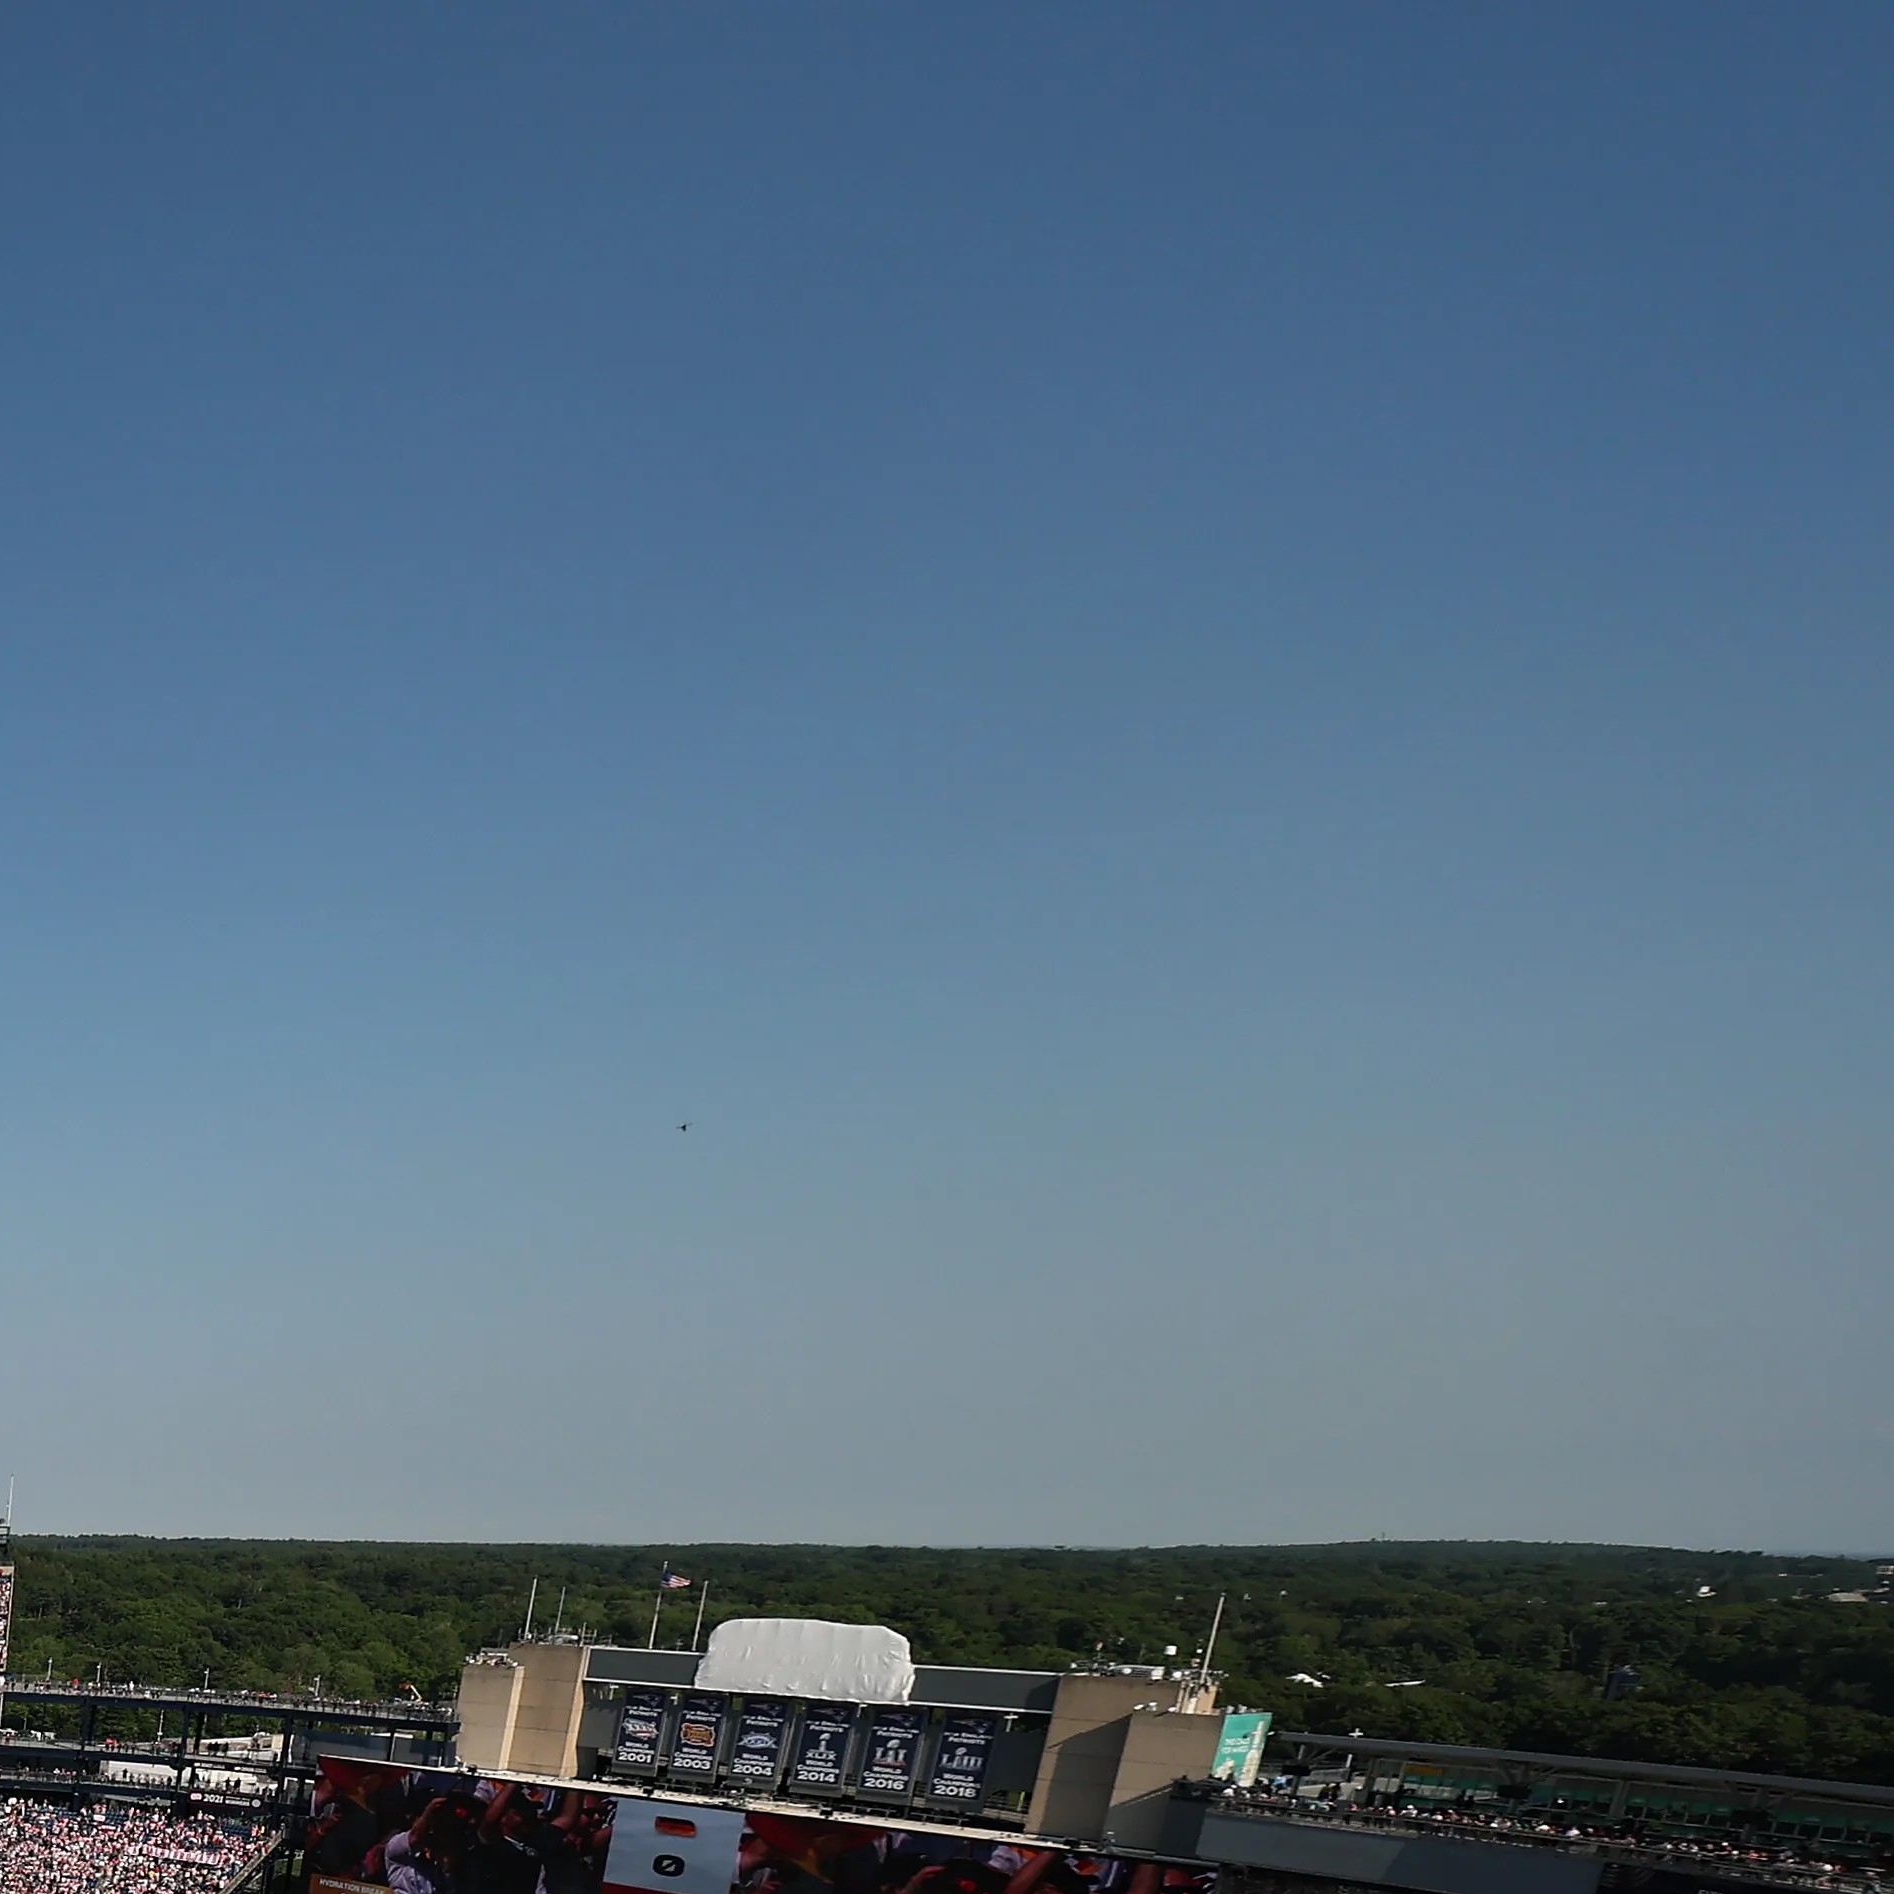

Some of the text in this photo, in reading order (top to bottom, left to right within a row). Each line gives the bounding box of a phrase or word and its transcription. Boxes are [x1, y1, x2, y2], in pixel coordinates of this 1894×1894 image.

[619, 1752, 652, 1763] 2001
[806, 1759, 834, 1767] WORLD
[673, 1758, 711, 1770] 2003
[797, 1764, 840, 1774] CHAMPIONS
[732, 1764, 772, 1776] 2004
[872, 1766, 902, 1774] WORLD
[797, 1771, 836, 1783] 2014
[863, 1771, 909, 1781] CHAMPIONS
[943, 1773, 974, 1782] WORLD
[863, 1778, 905, 1790] 2016
[934, 1778, 981, 1789] CHAMPIONS
[934, 1784, 977, 1798] 2018
[654, 1854, 685, 1877] 0
[319, 1878, 361, 1892] HYDRATION
